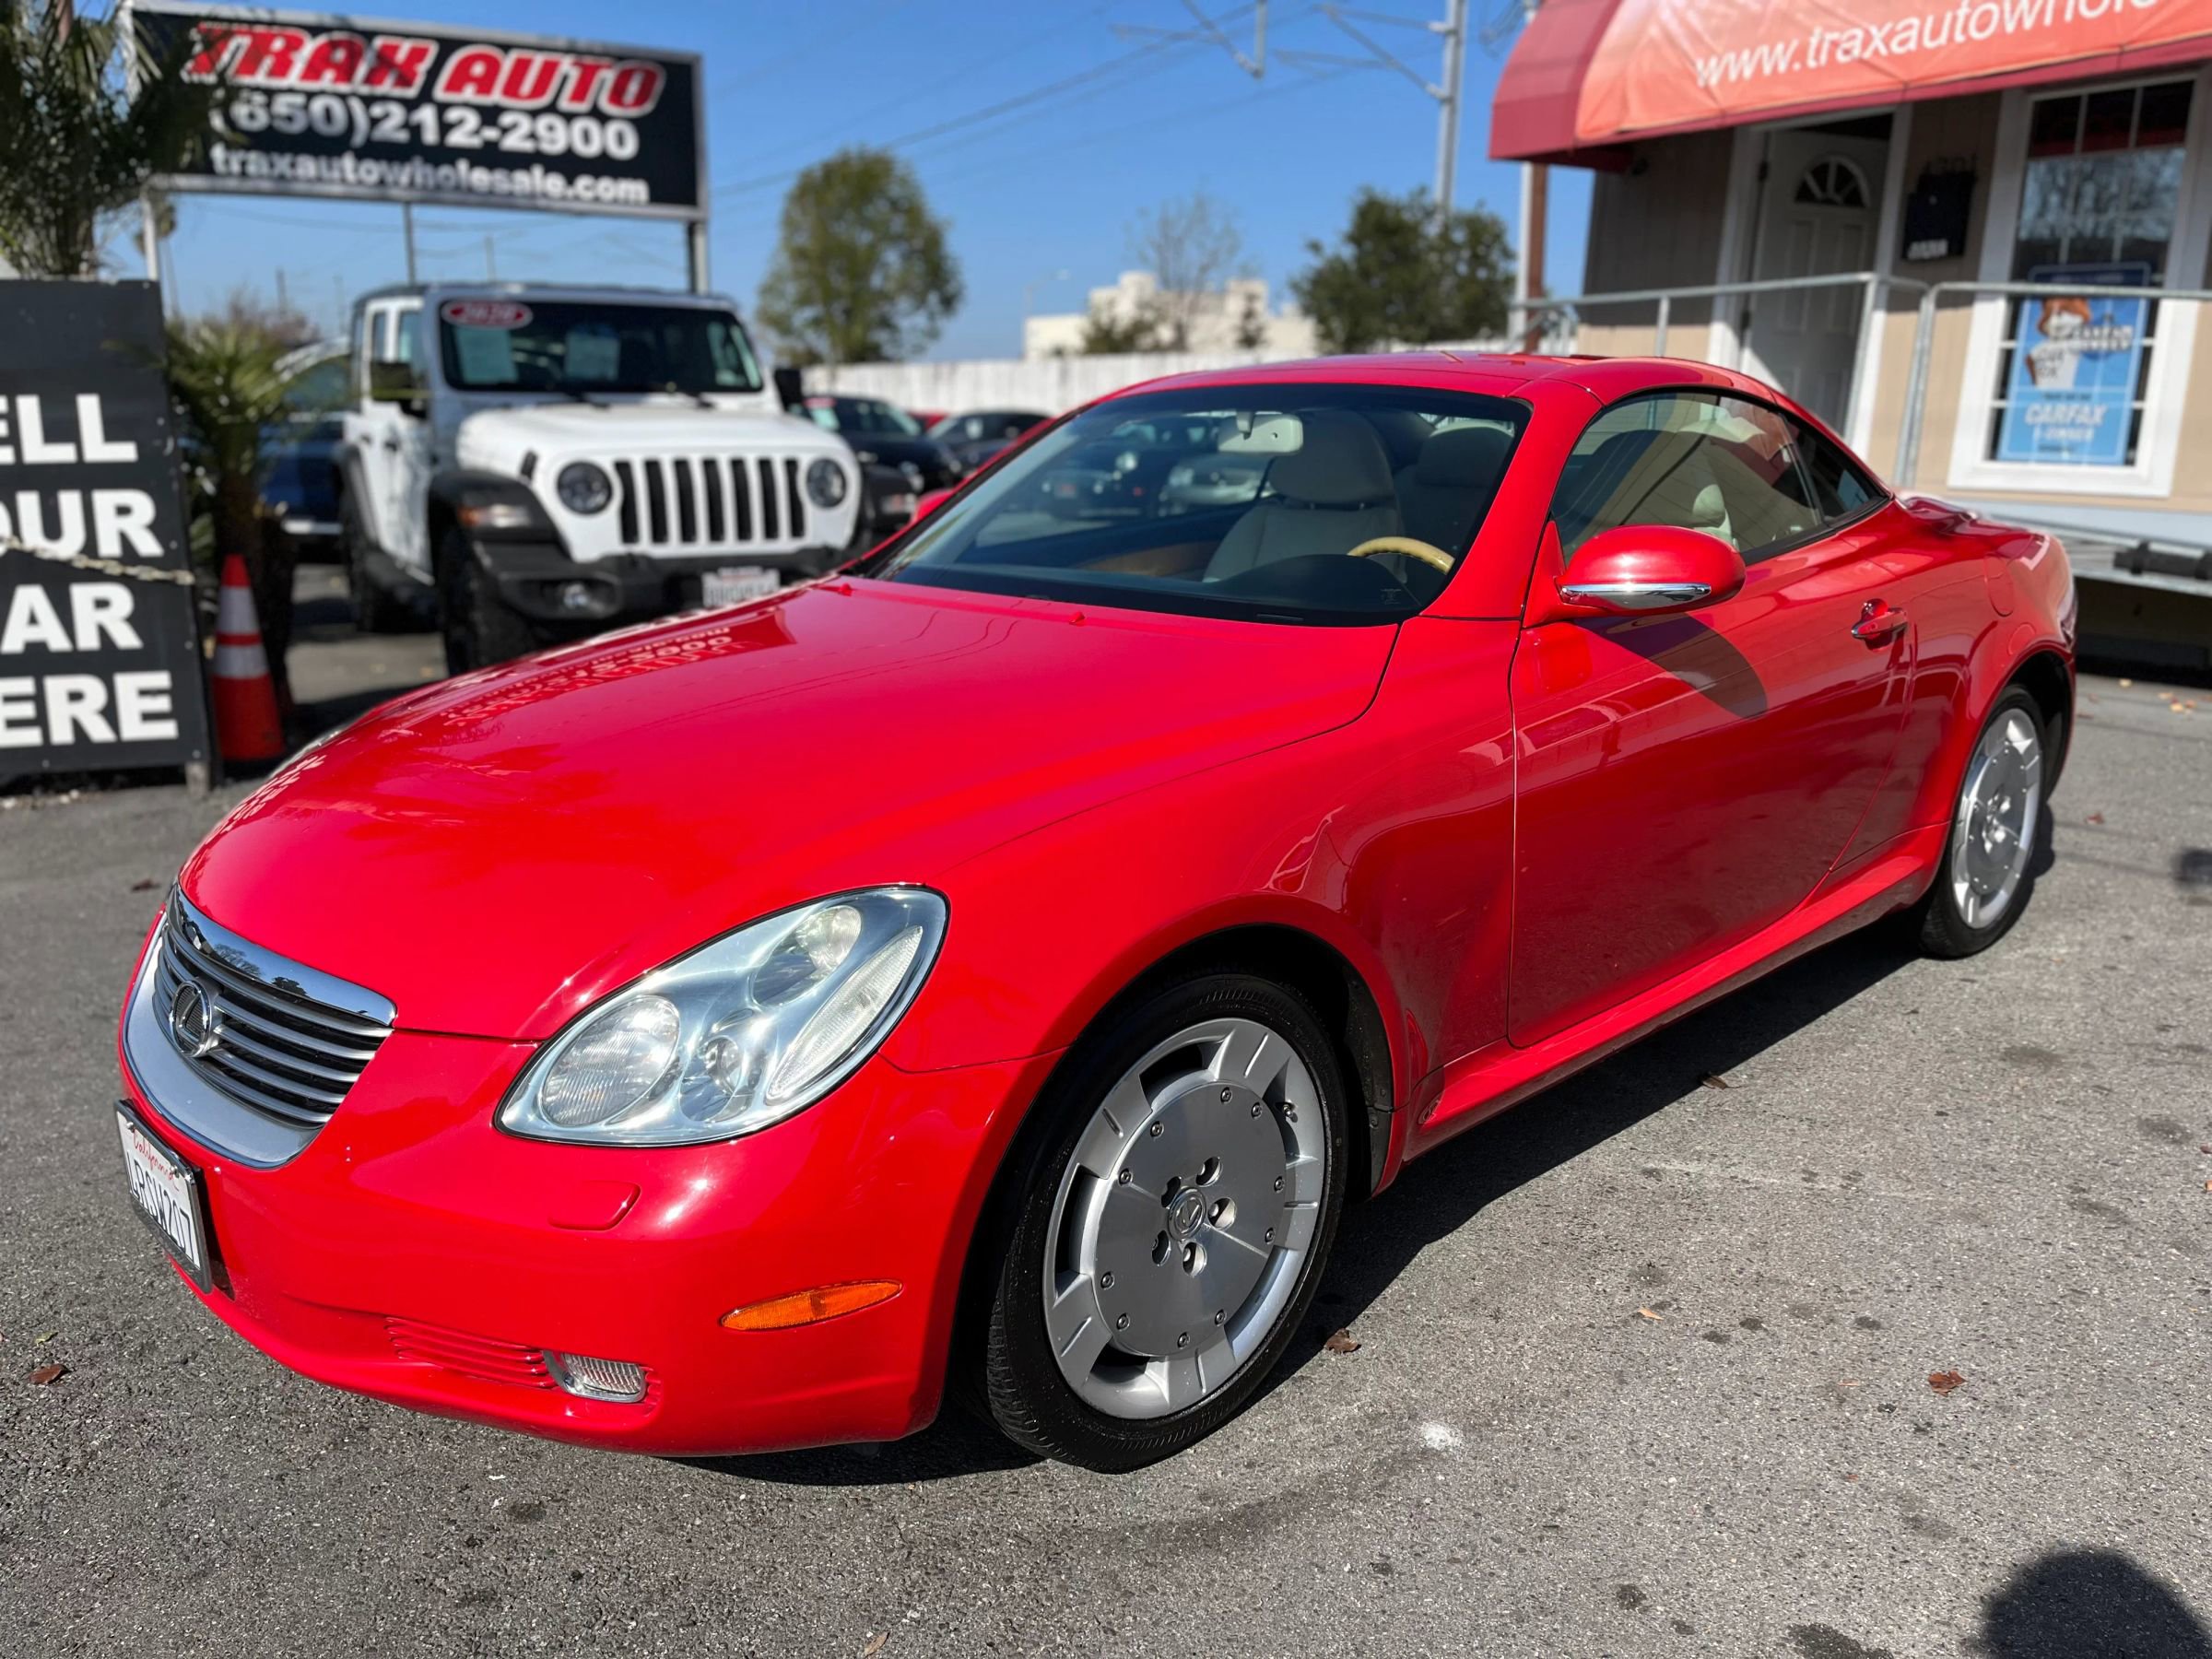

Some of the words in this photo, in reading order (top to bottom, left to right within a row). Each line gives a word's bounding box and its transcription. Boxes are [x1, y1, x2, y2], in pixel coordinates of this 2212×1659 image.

[183, 20, 439, 99] TRAX
[430, 43, 667, 118] AUTO
[208, 88, 640, 161] (650)212-2900
[209, 141, 651, 205] traxautowholesale.com
[0, 394, 138, 465] LL
[0, 488, 165, 560] UR
